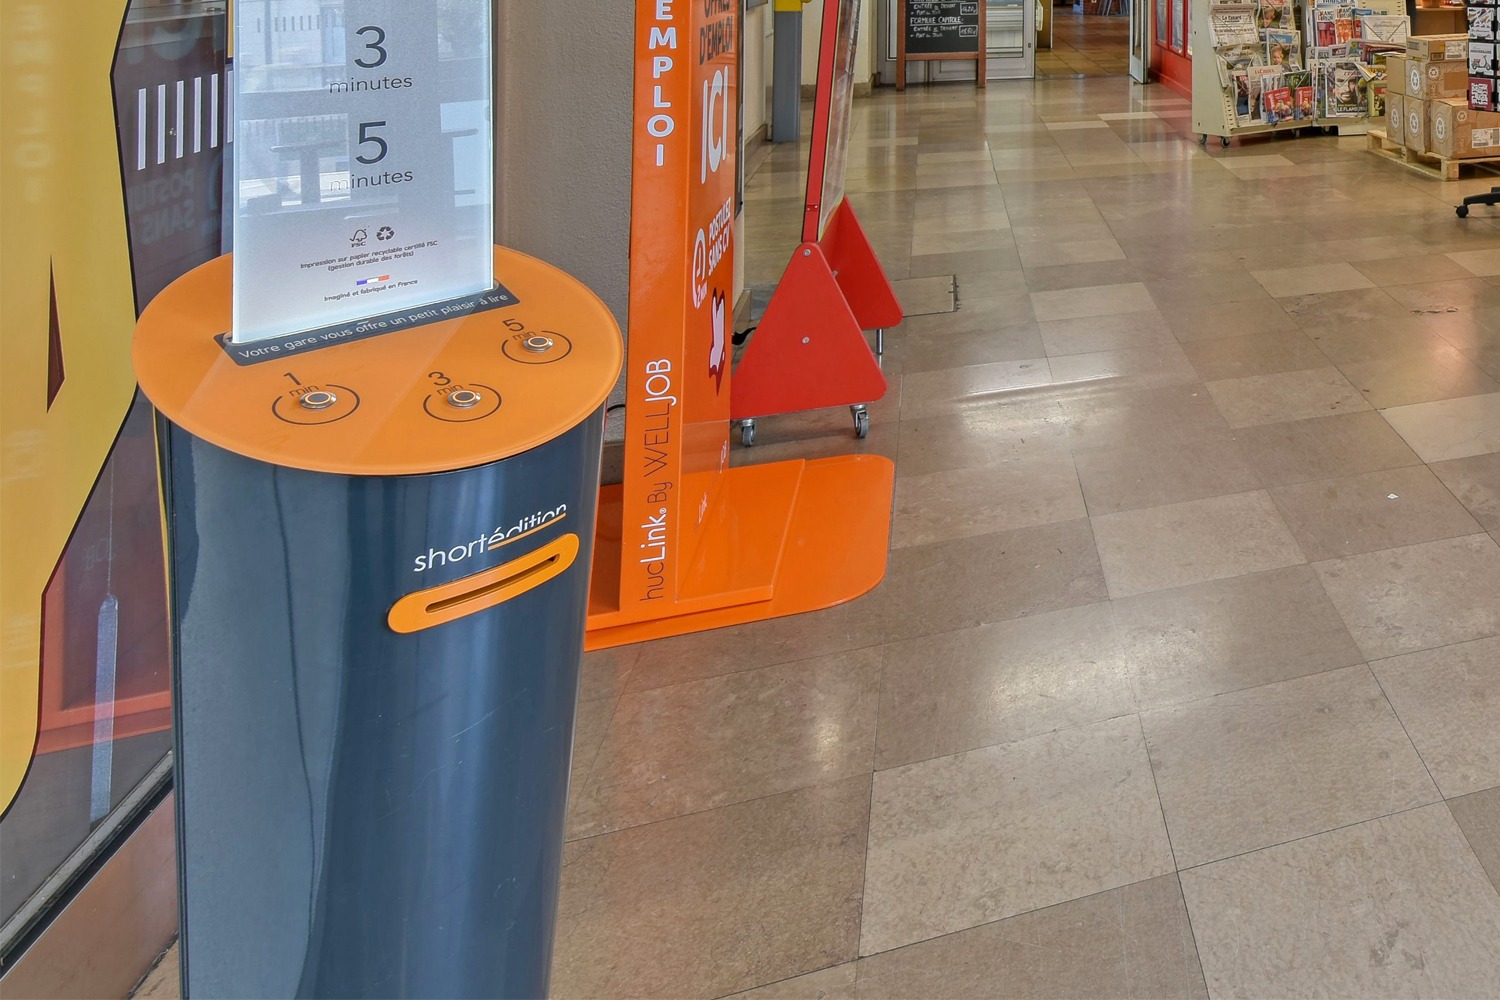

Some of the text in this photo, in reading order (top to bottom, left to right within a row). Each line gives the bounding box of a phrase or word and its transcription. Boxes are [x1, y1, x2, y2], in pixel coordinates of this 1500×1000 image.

[354, 25, 388, 68] 3
[700, 16, 733, 65] D'EMPLOI
[329, 75, 413, 94] minutes
[355, 120, 388, 164] 5
[701, 65, 729, 184] ICI
[329, 168, 414, 191] minutes
[709, 196, 731, 246] POSTULEZ
[300, 258, 336, 269] Impression
[349, 251, 370, 262] papier
[371, 246, 403, 257] recyclable
[404, 241, 426, 251] certifié
[426, 239, 438, 247] FSC
[327, 261, 354, 272] (gestion
[356, 257, 379, 266] durable
[394, 250, 414, 259] forêts)
[708, 222, 731, 276] SANS CV
[238, 292, 509, 358] Votre gare vous offre un petit plaisir à lire
[502, 318, 525, 331] 5
[283, 372, 302, 386] 1
[427, 371, 452, 387] 3
[644, 359, 677, 478] WELLJOB
[648, 481, 673, 503] By
[413, 503, 568, 573] shortédition
